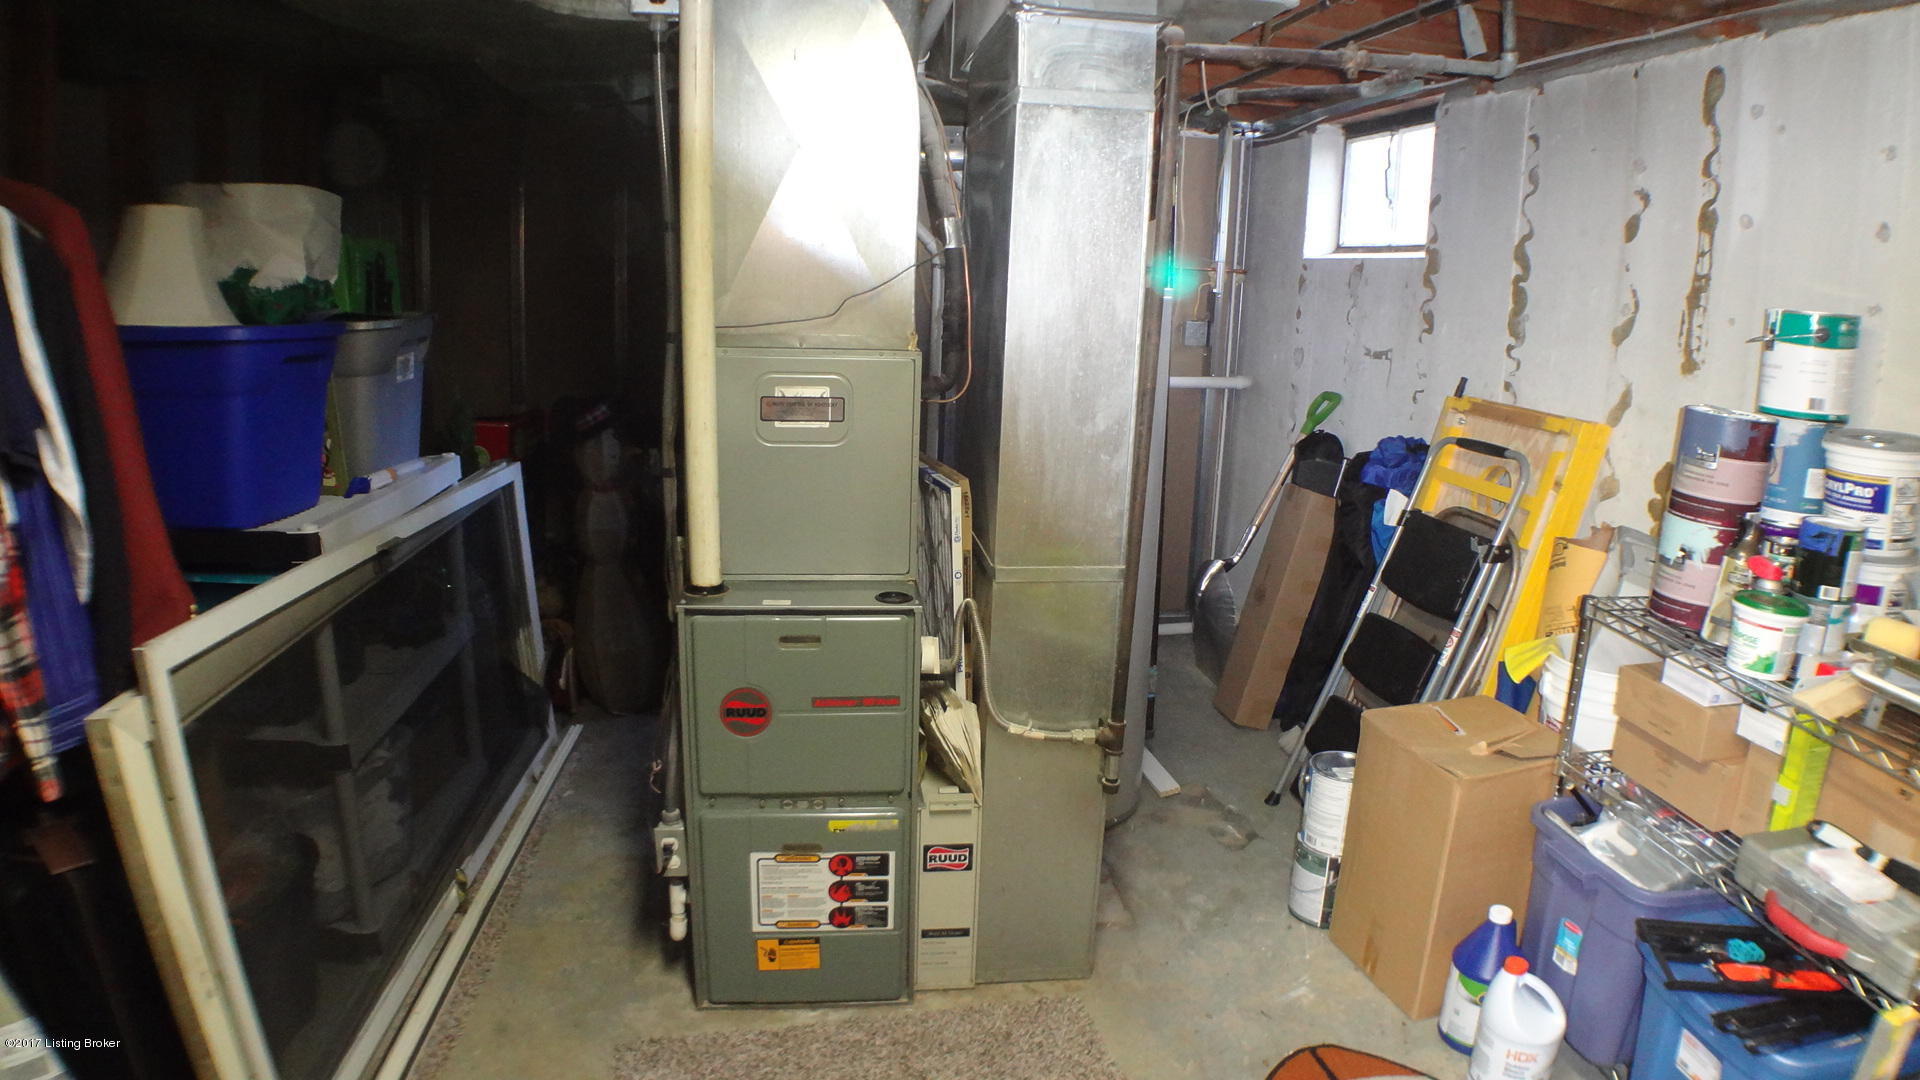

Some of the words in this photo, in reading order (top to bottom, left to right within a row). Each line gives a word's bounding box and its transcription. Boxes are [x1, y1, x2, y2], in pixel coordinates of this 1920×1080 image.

[726, 707, 767, 718] RUUD
[928, 853, 968, 863] RUUD
[1505, 1048, 1538, 1063] HDX
